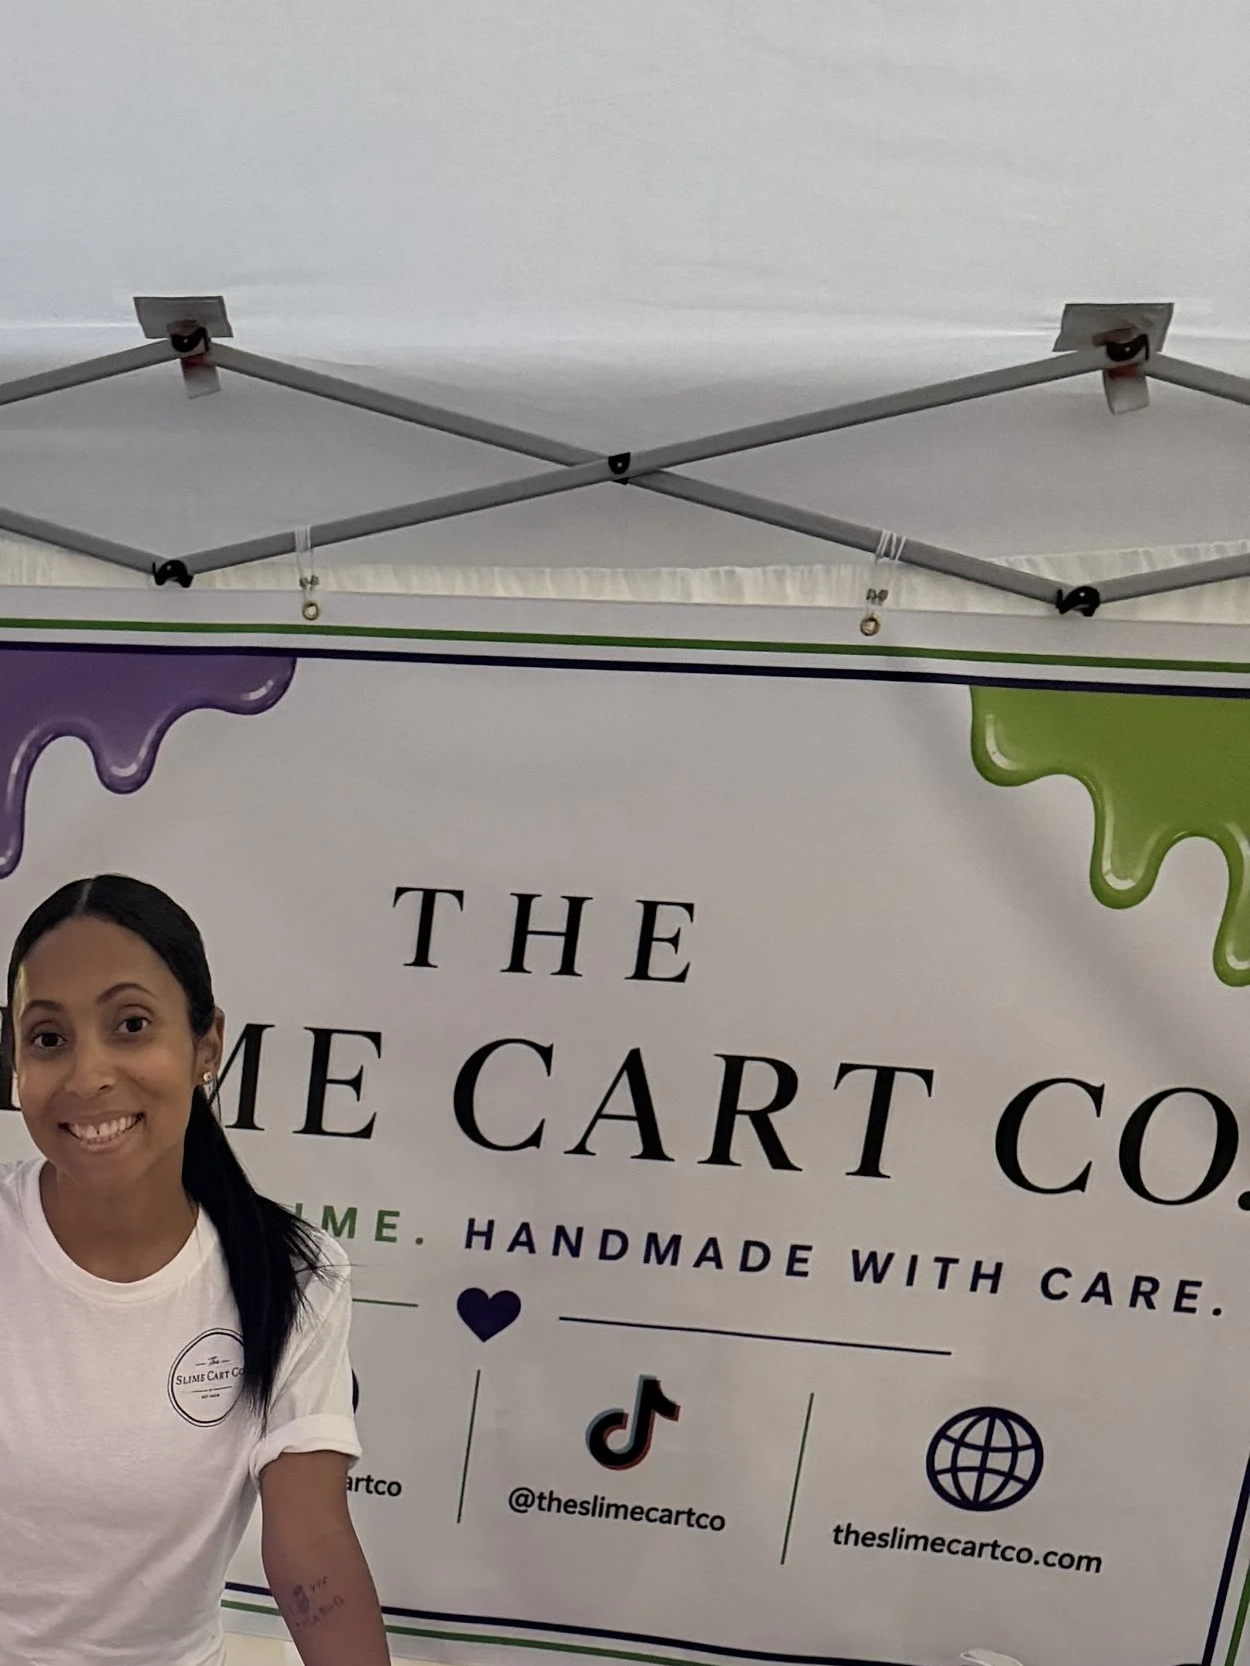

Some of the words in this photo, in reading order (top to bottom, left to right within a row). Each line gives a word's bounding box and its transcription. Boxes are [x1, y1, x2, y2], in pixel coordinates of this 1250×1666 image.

[392, 886, 695, 983] THE
[452, 1037, 935, 1179] CART
[994, 1077, 1250, 1212] CO.
[465, 1217, 814, 1278] HANDMADE
[851, 1249, 1004, 1295] WITH
[1040, 1266, 1225, 1317] CARE.
[175, 1373, 205, 1386] SLIME
[207, 1370, 230, 1382] CART
[508, 1486, 726, 1532] @theslimecartco
[832, 1522, 1102, 1574] theslimecartco.com
